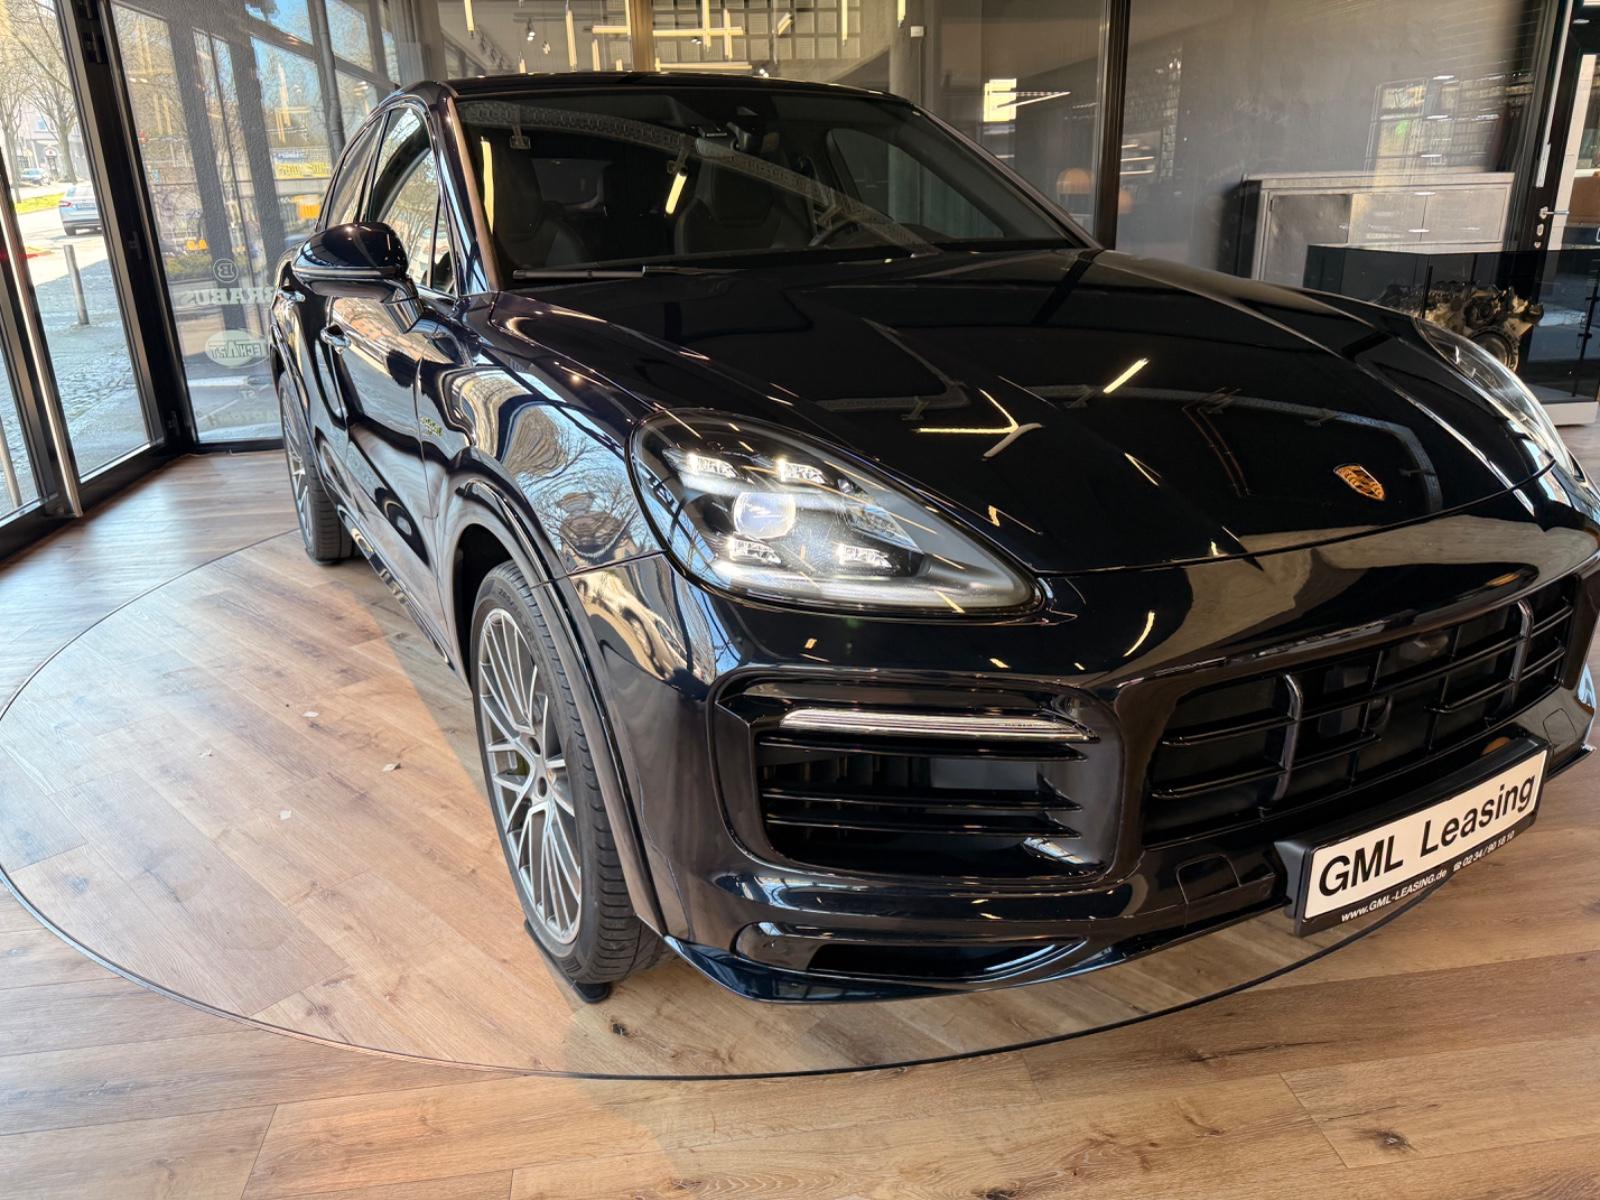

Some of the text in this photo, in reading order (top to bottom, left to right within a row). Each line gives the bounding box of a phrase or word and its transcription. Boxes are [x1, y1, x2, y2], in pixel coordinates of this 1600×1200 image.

[1319, 774, 1536, 897] GML Leasing
[1341, 868, 1447, 922] www.GML-LEASING.de
